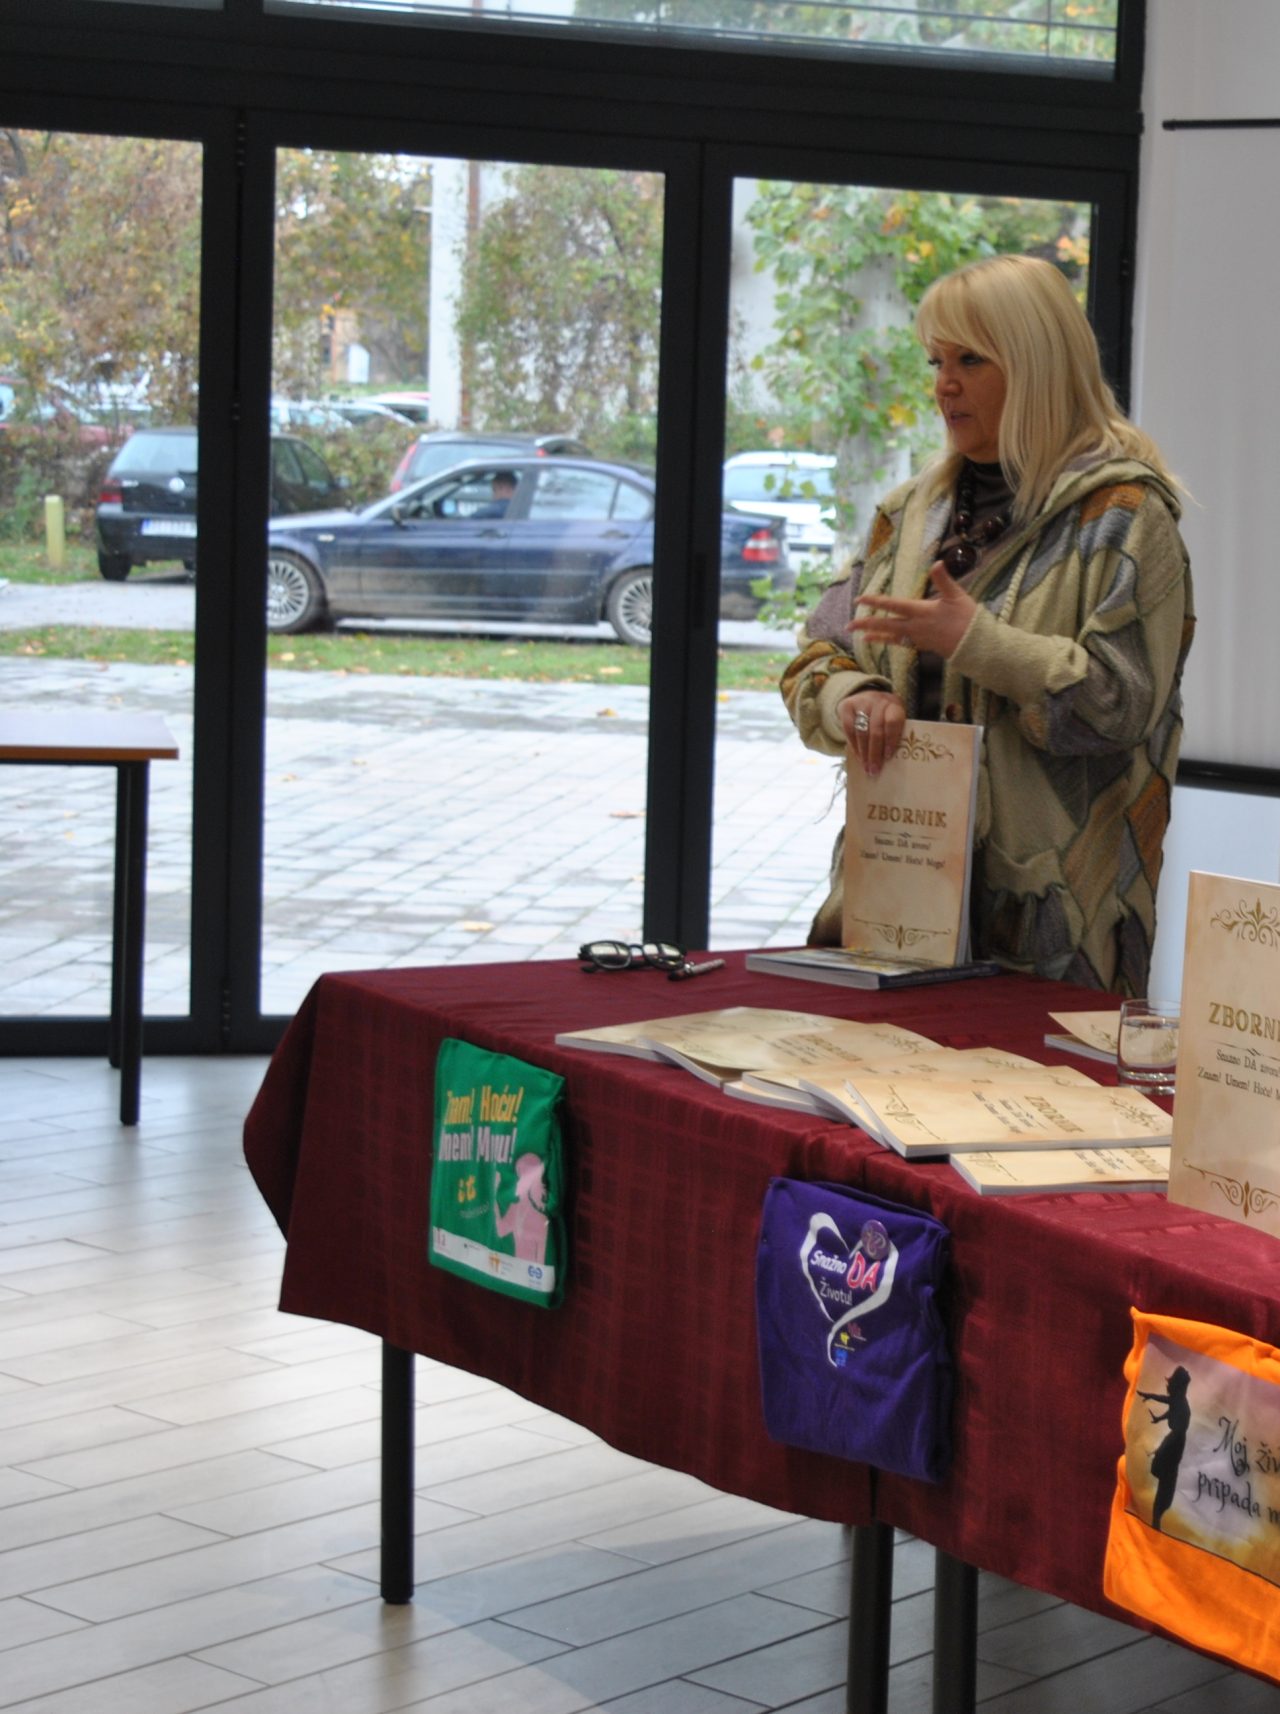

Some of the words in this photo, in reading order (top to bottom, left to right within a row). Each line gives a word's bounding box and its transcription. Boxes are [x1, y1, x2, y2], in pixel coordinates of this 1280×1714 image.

[867, 803, 947, 829] ZBORNIK
[810, 1249, 848, 1275] Snažno
[847, 1251, 881, 1292] DA
[1213, 1416, 1250, 1477] Moj
[1194, 1470, 1262, 1518] pripada
